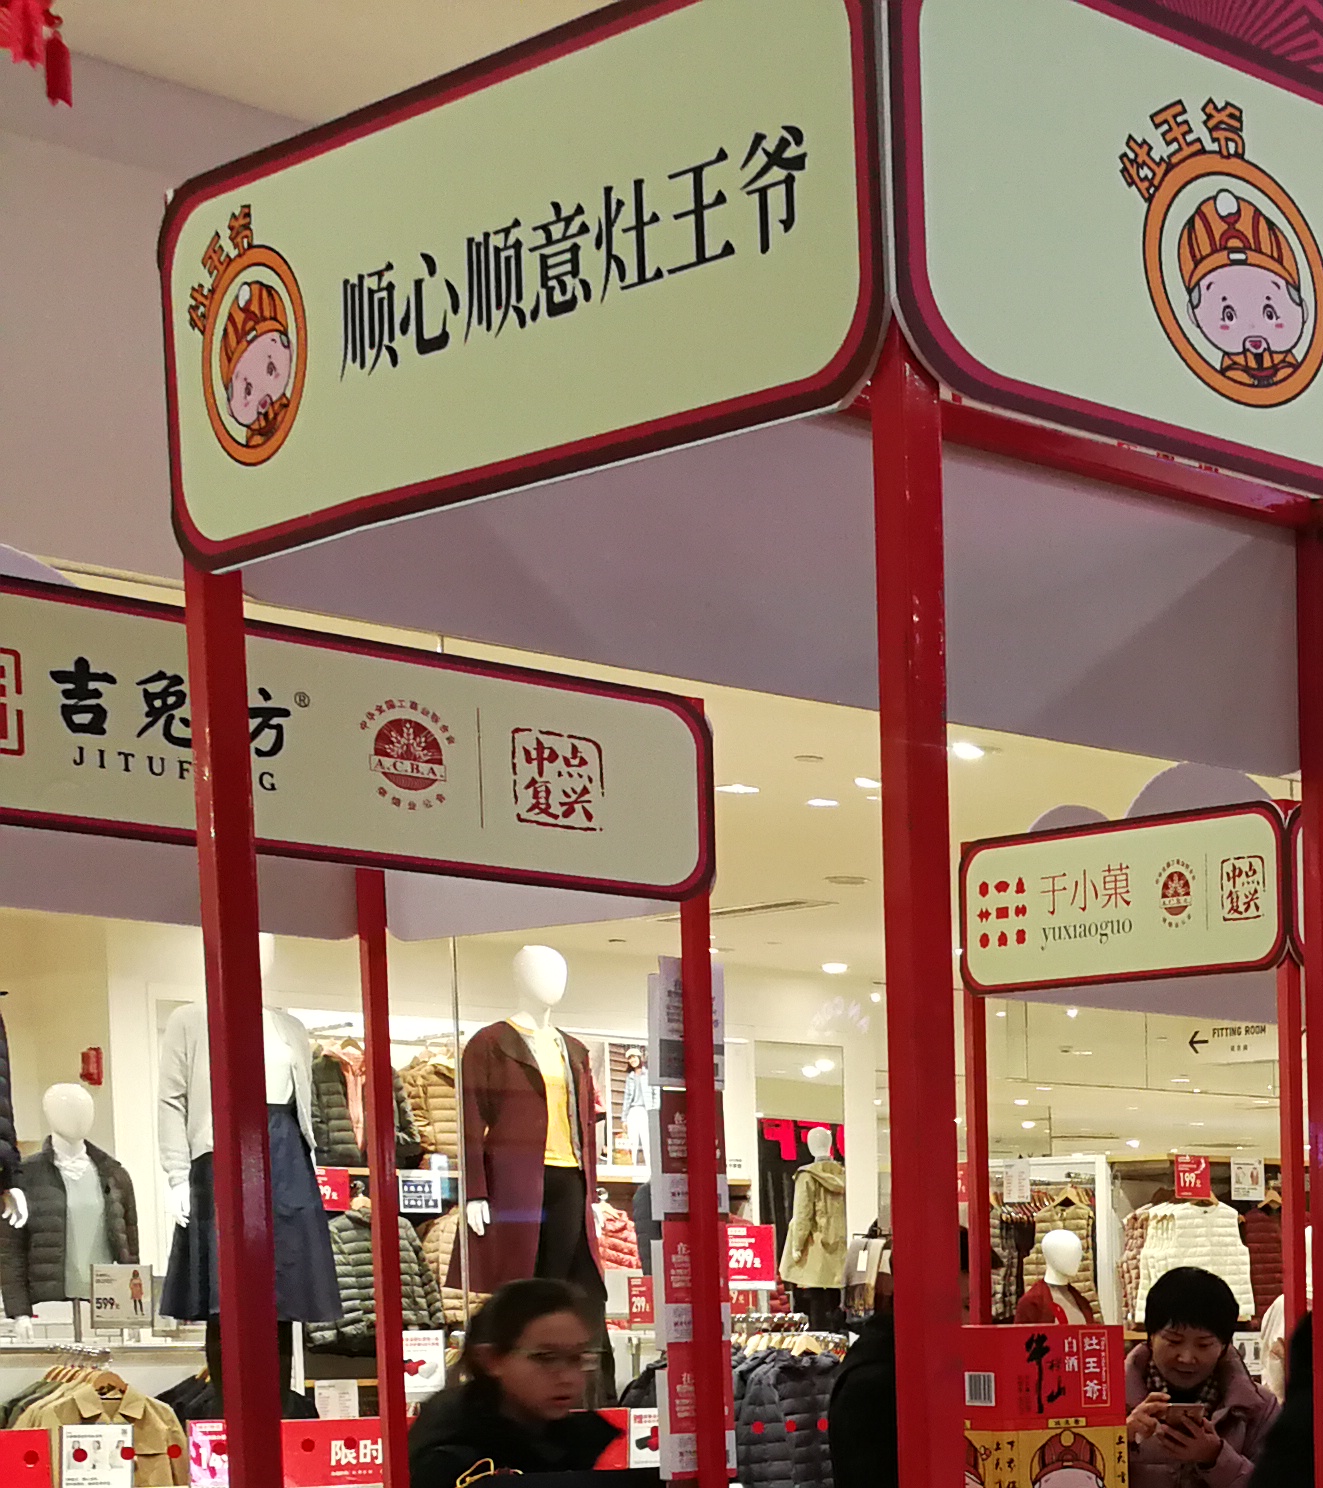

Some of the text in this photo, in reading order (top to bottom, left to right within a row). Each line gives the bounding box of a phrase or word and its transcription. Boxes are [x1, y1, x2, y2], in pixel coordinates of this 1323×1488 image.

[1118, 97, 1248, 202] 灶王爷
[340, 124, 808, 384] 顺心顺意灶王爷
[72, 744, 279, 793] JITUFG
[1040, 861, 1133, 917] 于小菓
[1040, 916, 1134, 951] yuxiaoguo
[1211, 1023, 1267, 1039] FITTING ROOM
[1063, 1336, 1079, 1373] 白酒
